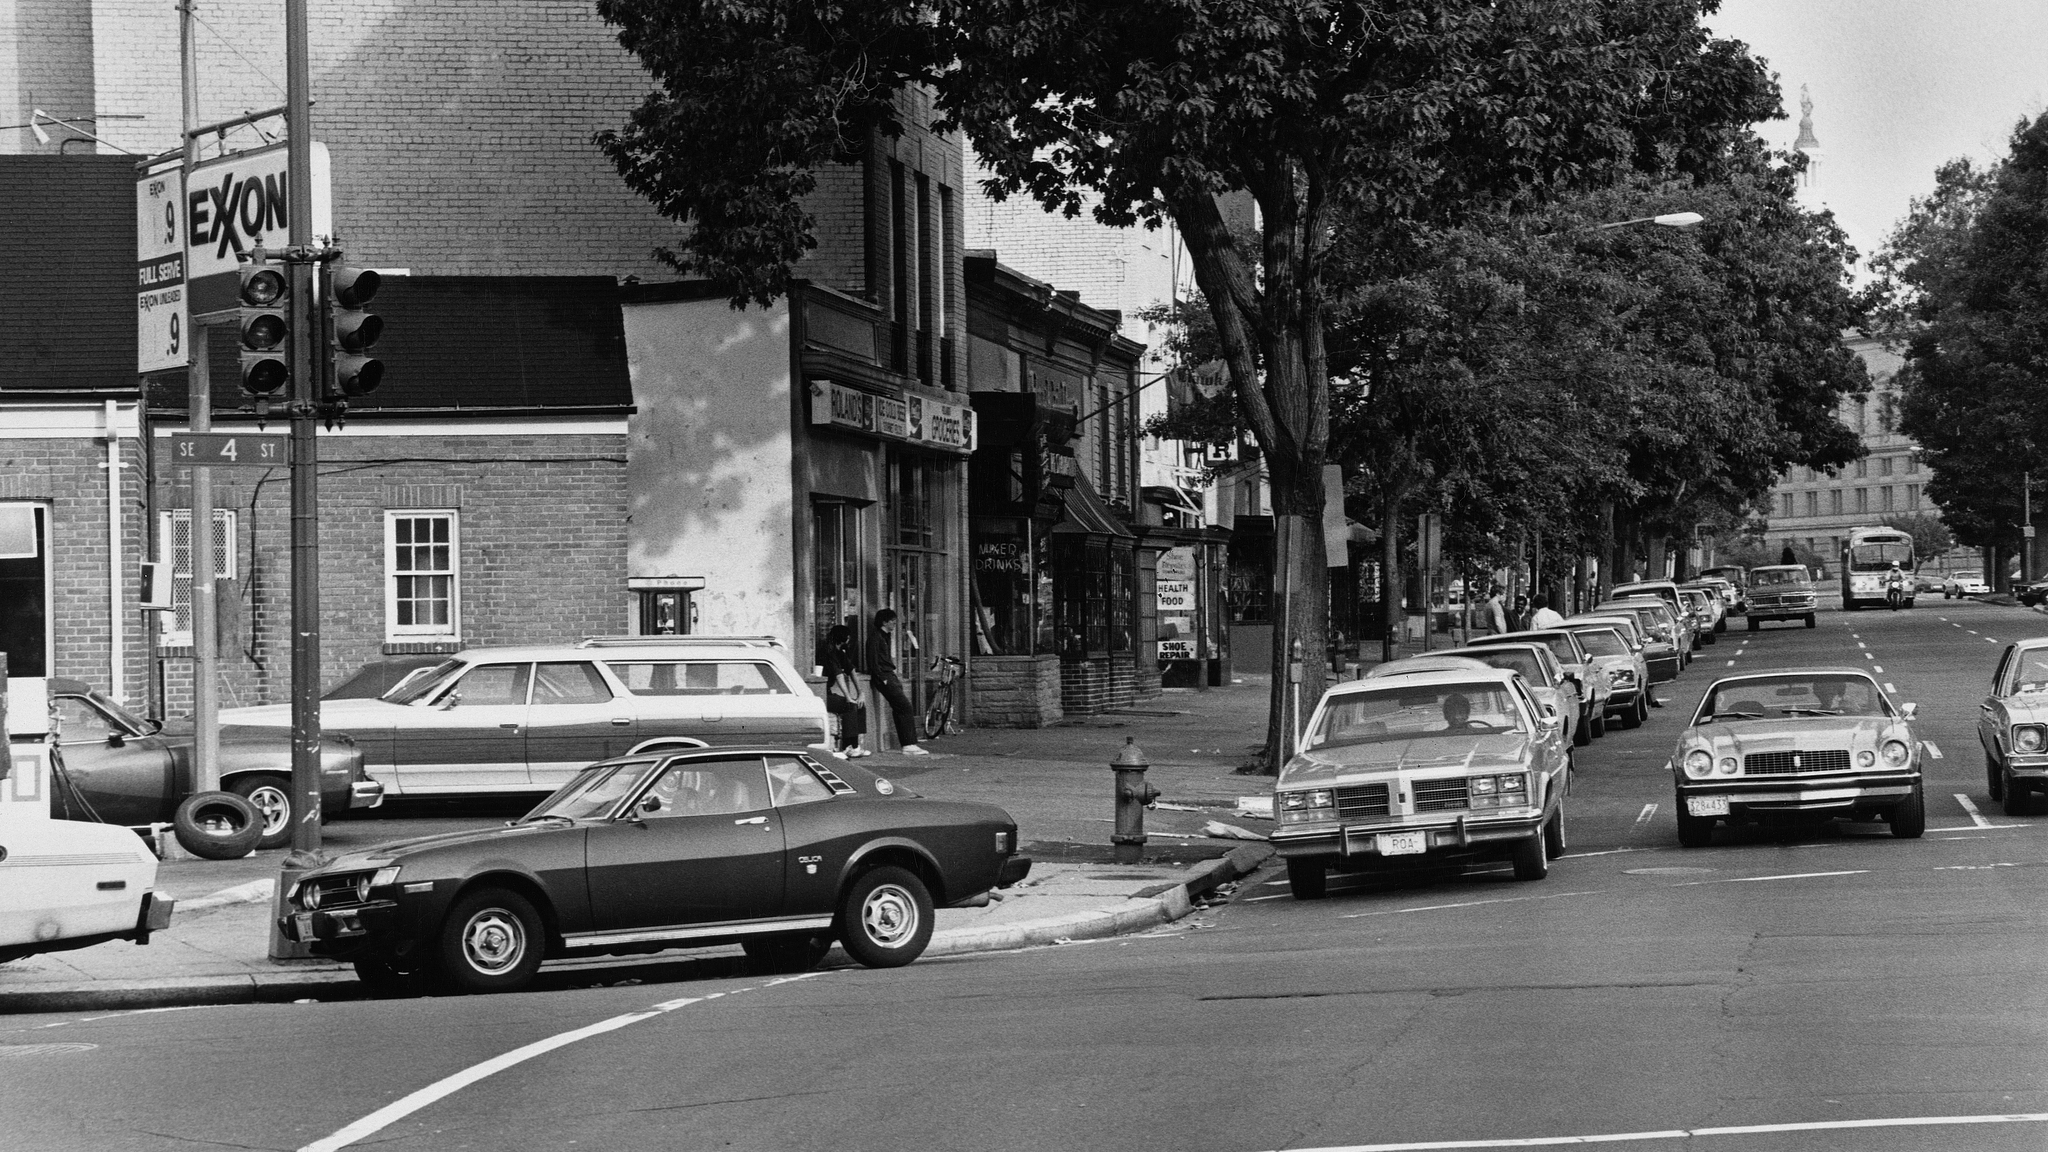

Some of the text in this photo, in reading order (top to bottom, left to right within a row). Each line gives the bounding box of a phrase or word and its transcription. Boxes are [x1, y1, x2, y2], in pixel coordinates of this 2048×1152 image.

[150, 180, 166, 199] EXXON
[189, 170, 288, 262] EXXON
[139, 260, 181, 286] FULL SERVE
[140, 293, 159, 313] EXXON
[831, 388, 862, 424] ROLAND'S
[932, 414, 960, 445] GROCERIES
[180, 438, 275, 462] SE 4 ST
[979, 543, 1017, 556] MIXED
[976, 558, 1022, 572] DRINKS
[1158, 584, 1189, 593] HEALTH
[1161, 597, 1184, 606] FOOD
[1159, 651, 1191, 659] REPAIR
[1162, 642, 1187, 652] SHOE
